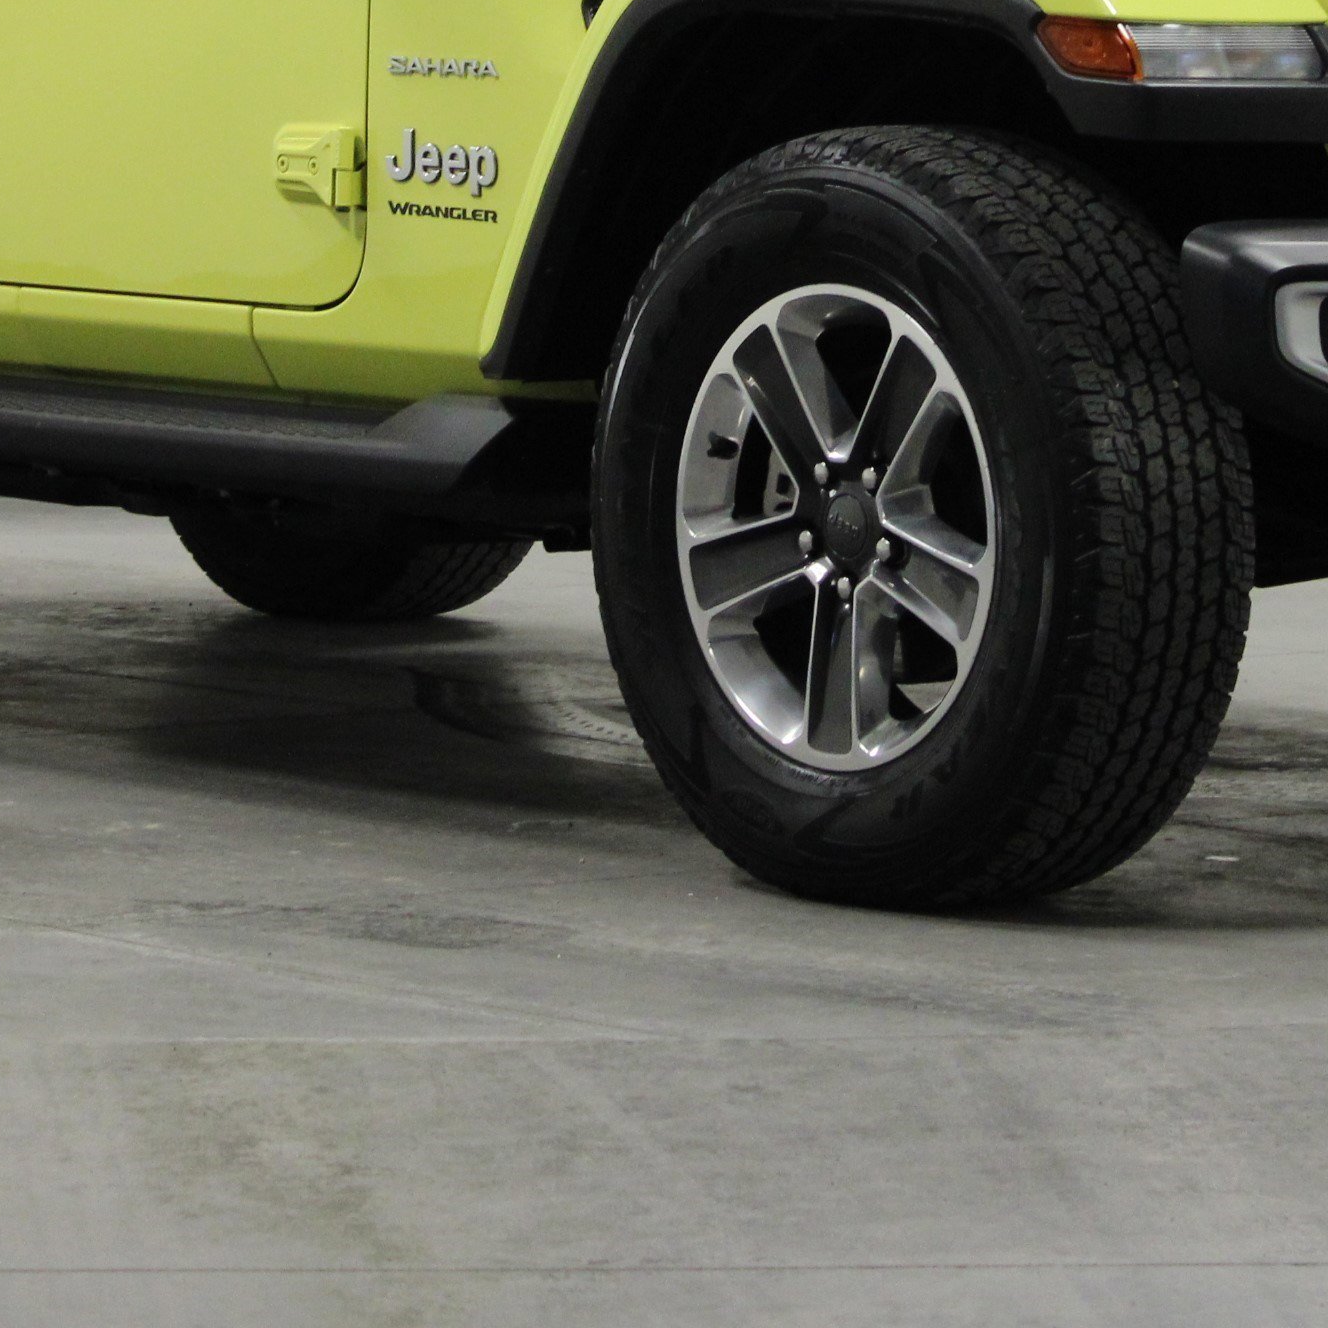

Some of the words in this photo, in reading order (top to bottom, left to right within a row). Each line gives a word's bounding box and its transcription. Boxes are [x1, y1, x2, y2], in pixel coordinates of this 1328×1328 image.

[388, 55, 499, 79] SAHARA
[385, 127, 499, 198] Jeep
[387, 200, 498, 223] WRANGLER
